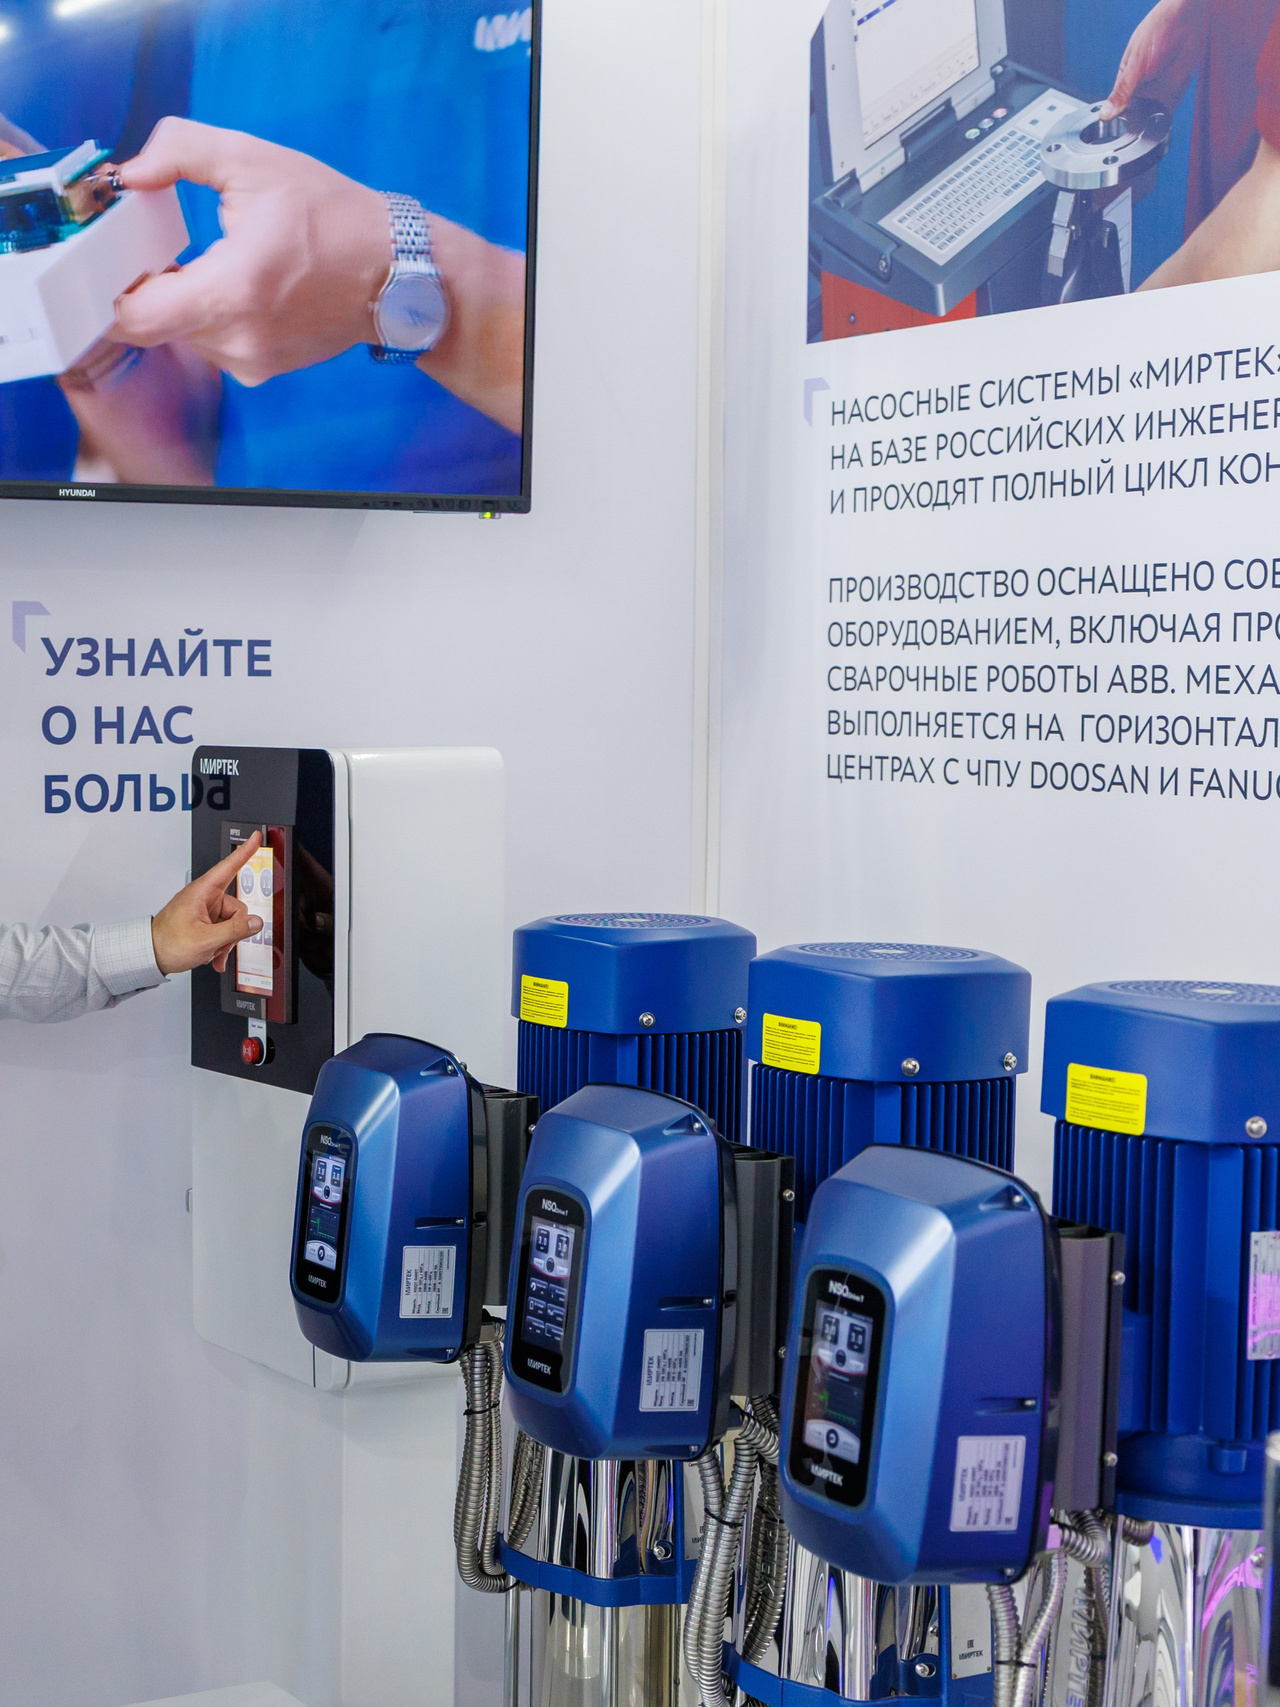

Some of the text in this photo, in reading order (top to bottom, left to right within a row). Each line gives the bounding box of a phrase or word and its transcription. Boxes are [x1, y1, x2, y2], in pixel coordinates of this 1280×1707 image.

[832, 345, 1280, 426] НАСОСНЫЕ СИСТЕМЫ «МИРТЕК
[831, 443, 863, 470] НА
[872, 436, 927, 466] БАЗЕ
[937, 414, 1125, 463] РОССИЙСКИХ
[59, 488, 96, 497] HYUNDAI
[831, 489, 844, 514] И
[854, 477, 984, 512] ПРОХОДЯТ
[993, 458, 1113, 502] ПОЛНЫЙ
[1126, 457, 1207, 496] ЦИКЛ
[829, 569, 1029, 603] ПРОИЗВОДСТВО
[1038, 561, 1214, 597] ОСНАЩЕНО
[828, 612, 1280, 650] ОБОРУДОВАНИЕМ, ВКЛЮЧАЯ ПР
[41, 628, 271, 677] УЗНАЙТЕ
[828, 666, 977, 692] СВАРОЧНЫЕ
[987, 665, 1097, 693] РОБОТЫ
[1187, 664, 1280, 694] МЕХА
[42, 706, 193, 745] О НАС
[828, 710, 1278, 747] ВЫПОЛНЯЕТСЯ НА ГОРИЗОНТАЛ
[200, 758, 239, 776] МИРТЕК
[828, 754, 1280, 800] ЦЕНТРАХ С ЧПУ DOOSAN И FANU
[527, 1358, 552, 1375] МИРТЕК
